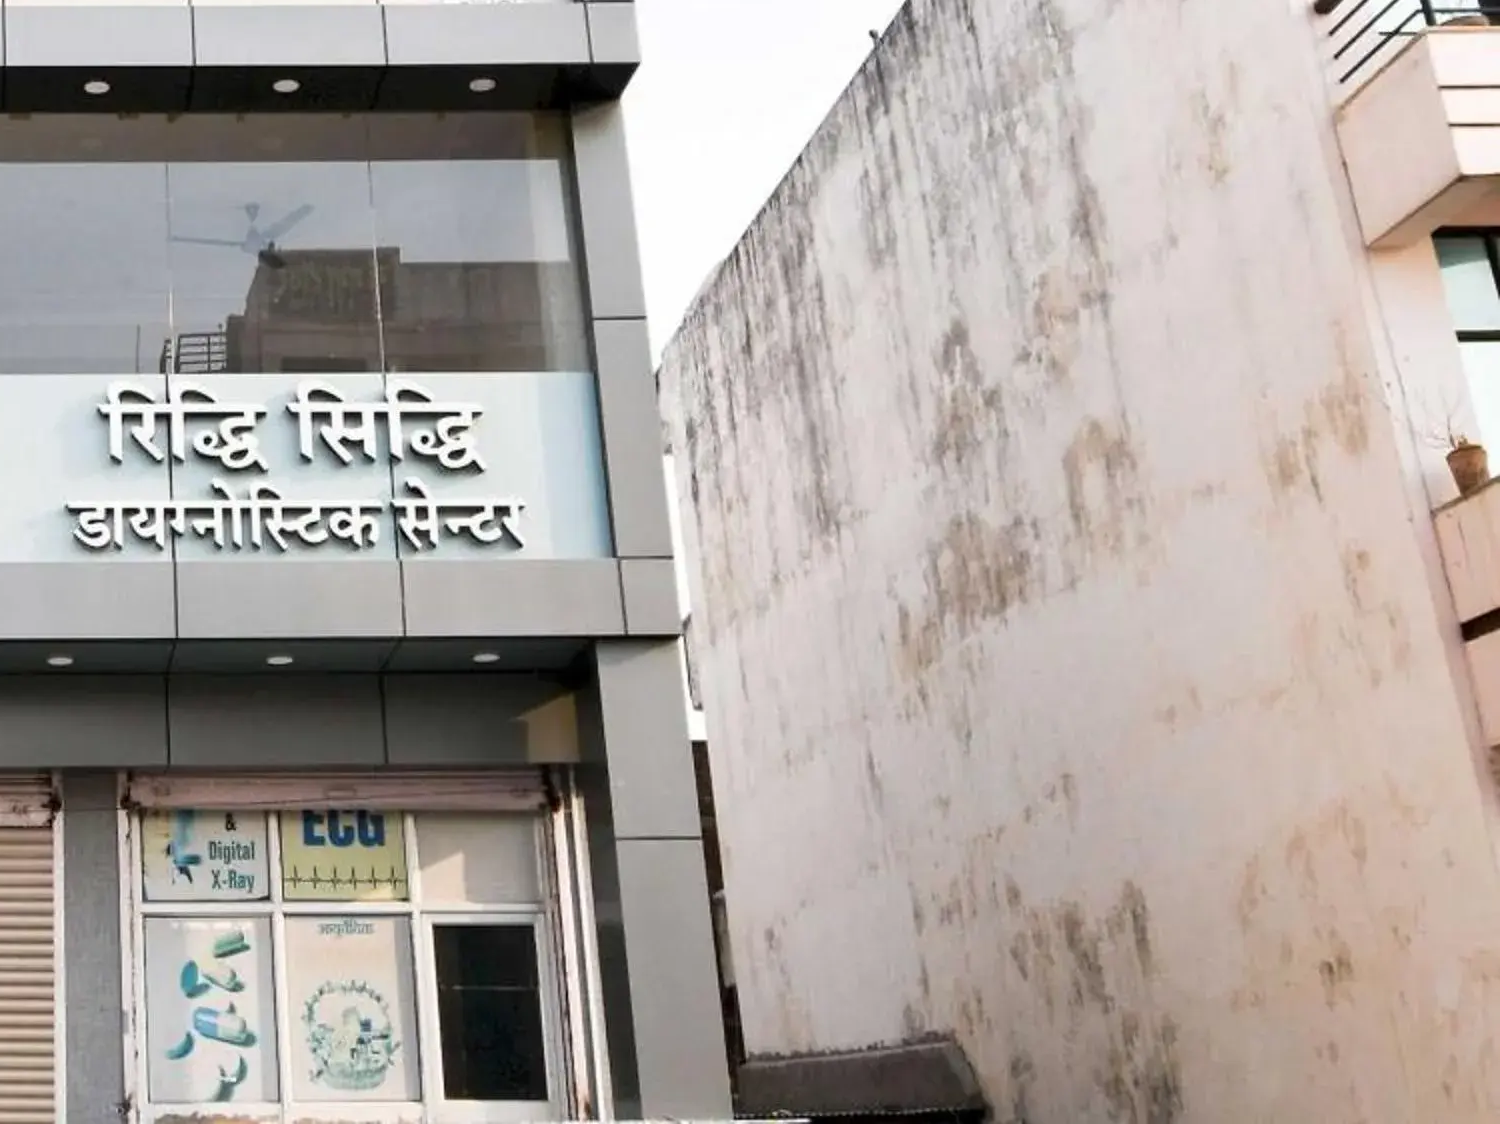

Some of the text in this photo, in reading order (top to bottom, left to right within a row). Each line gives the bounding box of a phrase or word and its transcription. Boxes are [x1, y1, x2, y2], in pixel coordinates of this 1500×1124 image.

[98, 380, 487, 473] रिद्धि सिद्धि
[66, 476, 527, 553] डायग्नोस्टिक सेन्टर
[224, 813, 237, 831] &
[303, 809, 385, 847] ECG
[208, 841, 256, 864] Digital
[211, 870, 255, 894] X-Ray
